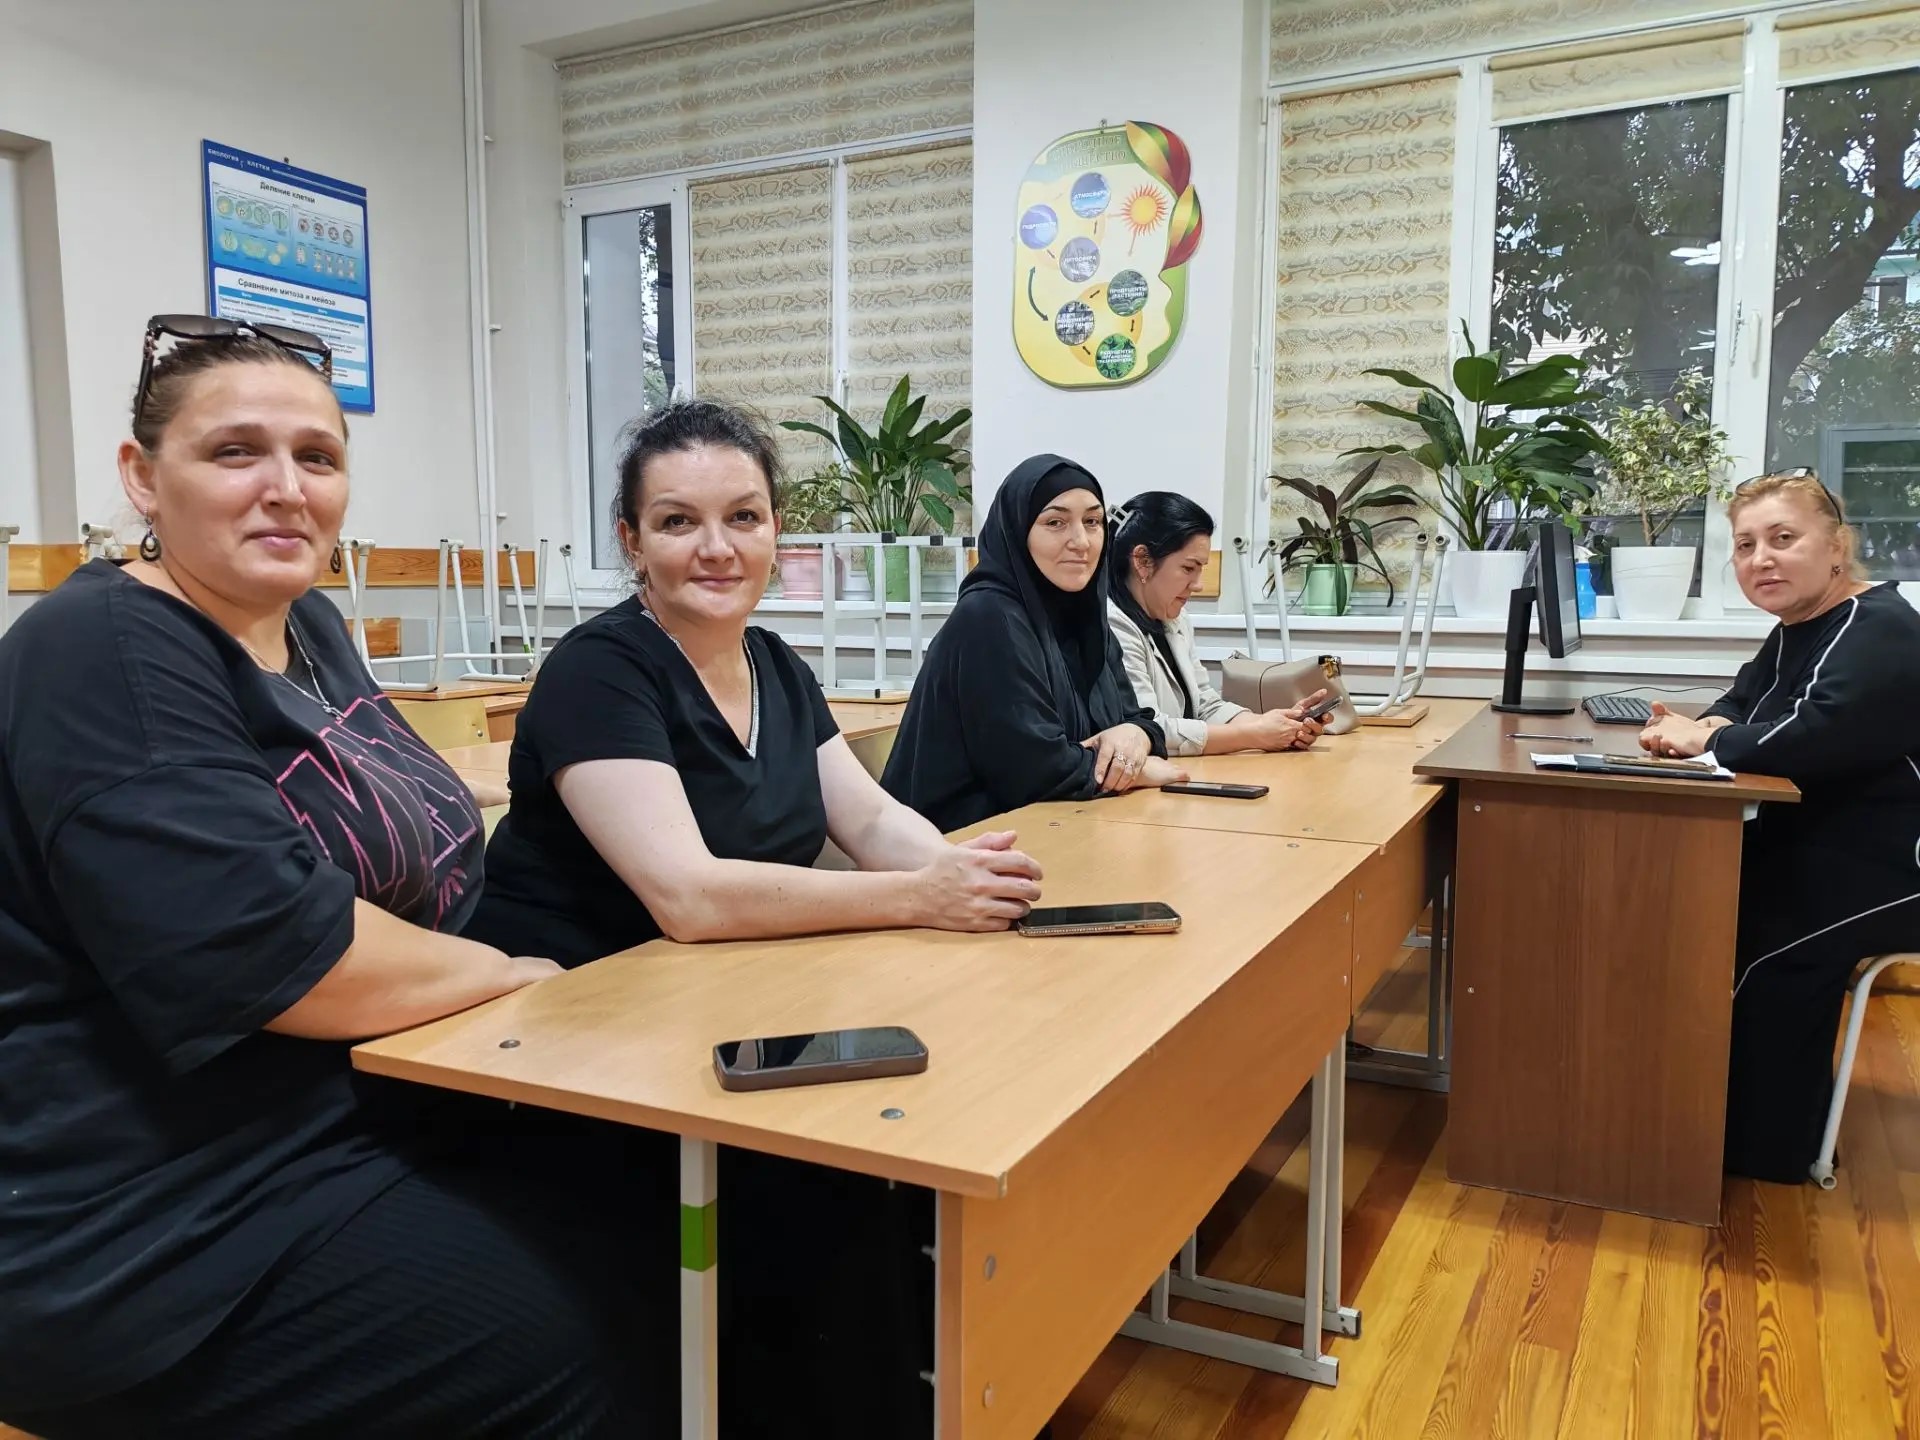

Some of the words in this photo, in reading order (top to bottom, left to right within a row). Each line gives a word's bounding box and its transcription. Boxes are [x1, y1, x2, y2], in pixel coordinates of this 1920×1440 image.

[260, 181, 291, 197] Деление
[292, 191, 315, 204] клетки
[238, 278, 279, 294] Сравнение
[279, 287, 304, 299] митоза
[311, 295, 336, 306] мейоза
